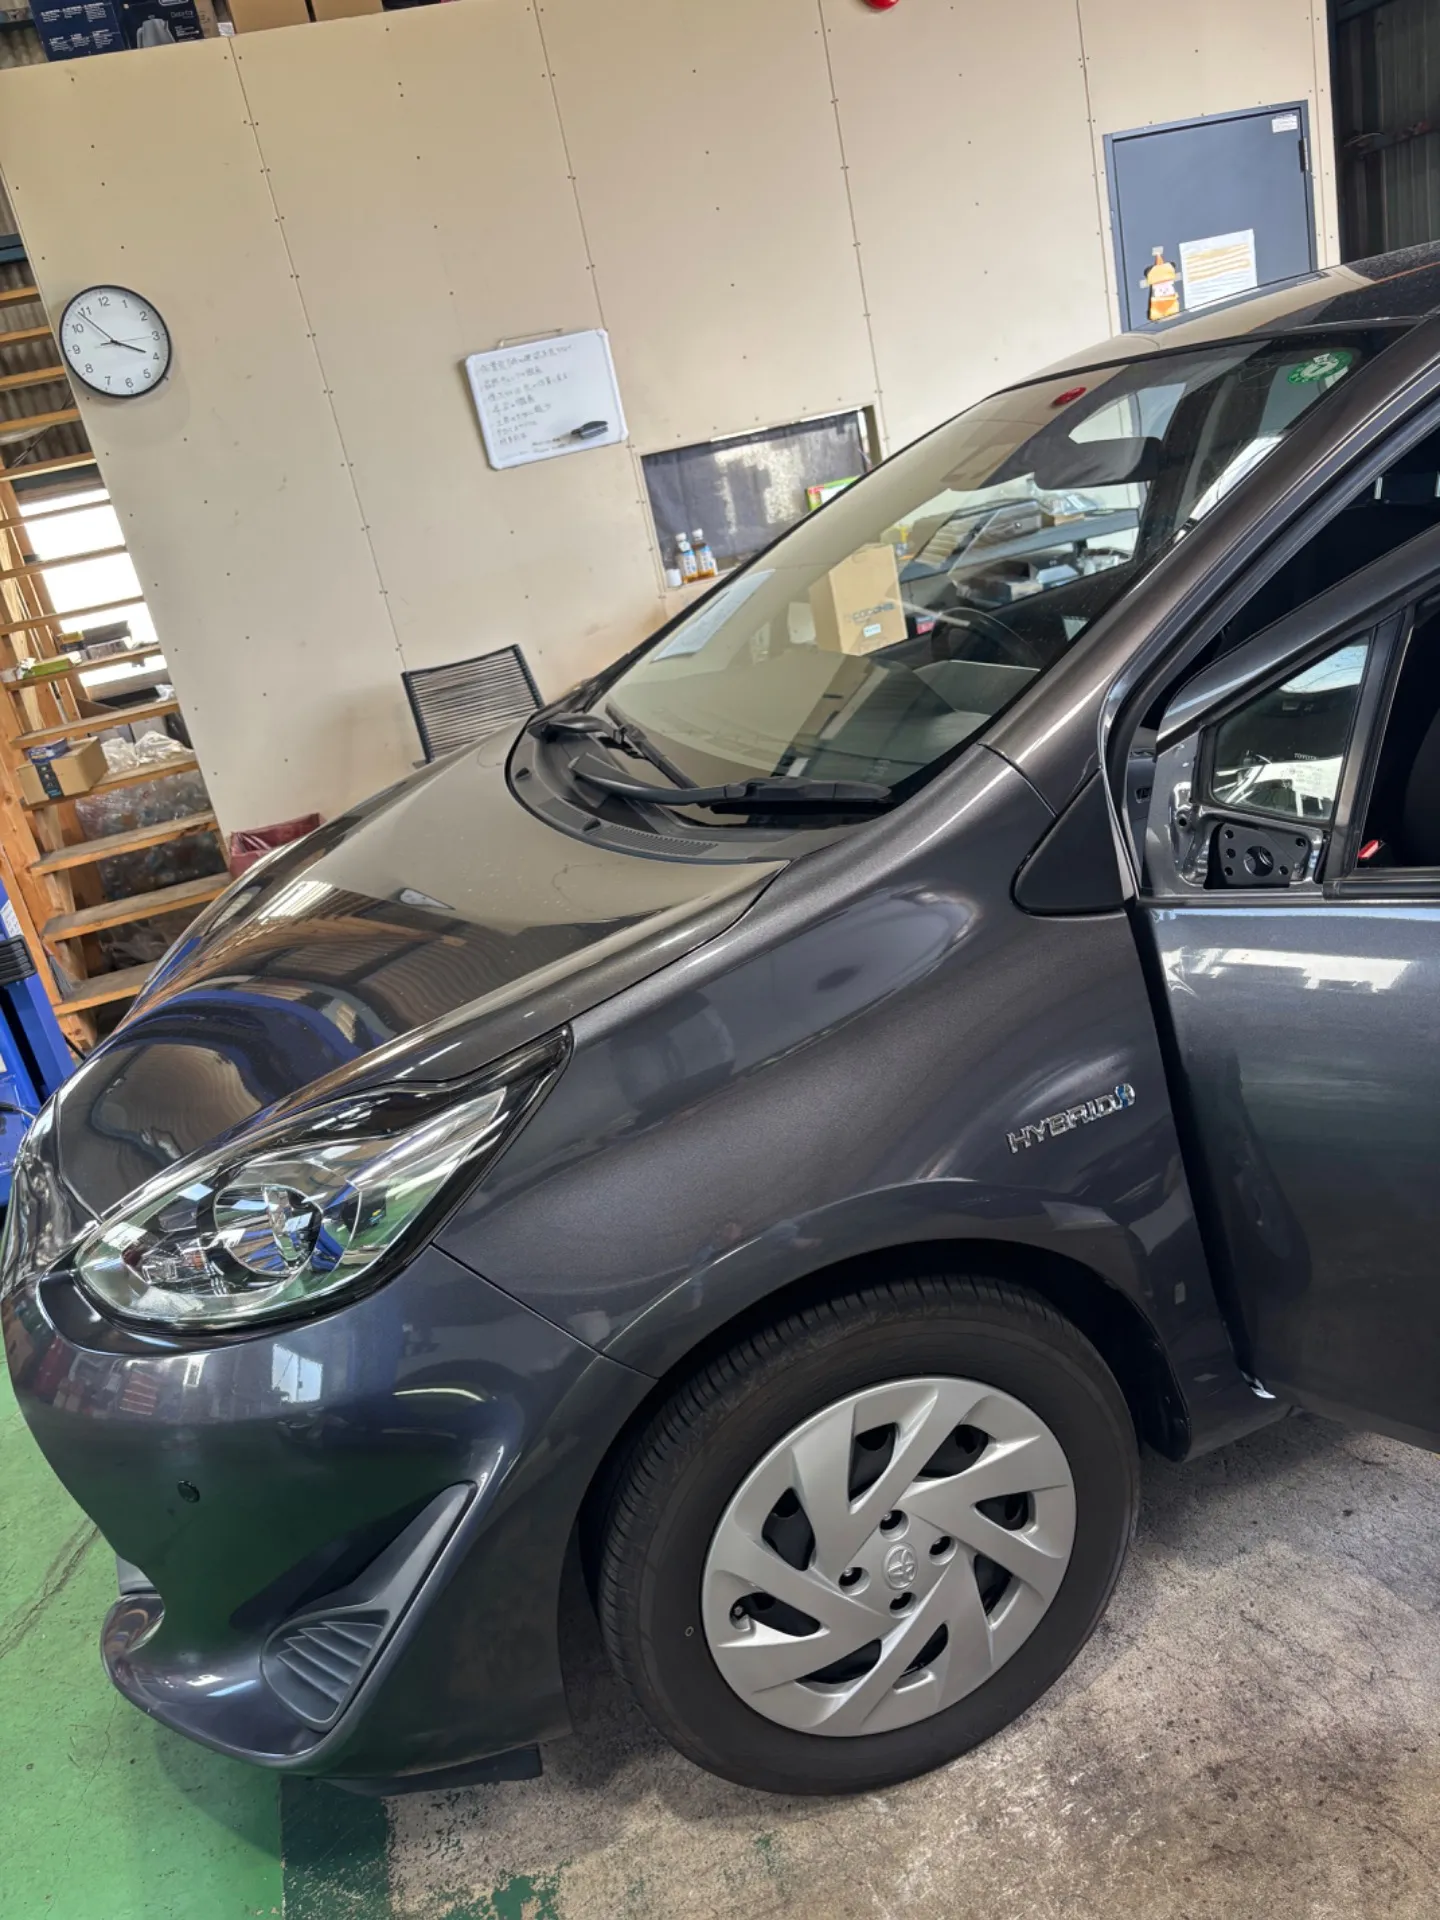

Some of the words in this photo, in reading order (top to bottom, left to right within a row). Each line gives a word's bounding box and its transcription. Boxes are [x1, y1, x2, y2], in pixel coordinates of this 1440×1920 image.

[98, 296, 111, 307] 12
[122, 299, 129, 309] 1
[80, 306, 93, 316] 11
[140, 311, 149, 322] 2
[72, 323, 84, 334] 10
[152, 331, 161, 341] 3
[72, 344, 81, 355] 9
[153, 352, 160, 360] 4
[85, 363, 94, 374] 8
[143, 368, 152, 379] 5
[105, 375, 112, 386] 7
[125, 377, 134, 389] 6
[1006, 1093, 1119, 1154] HYBRID
